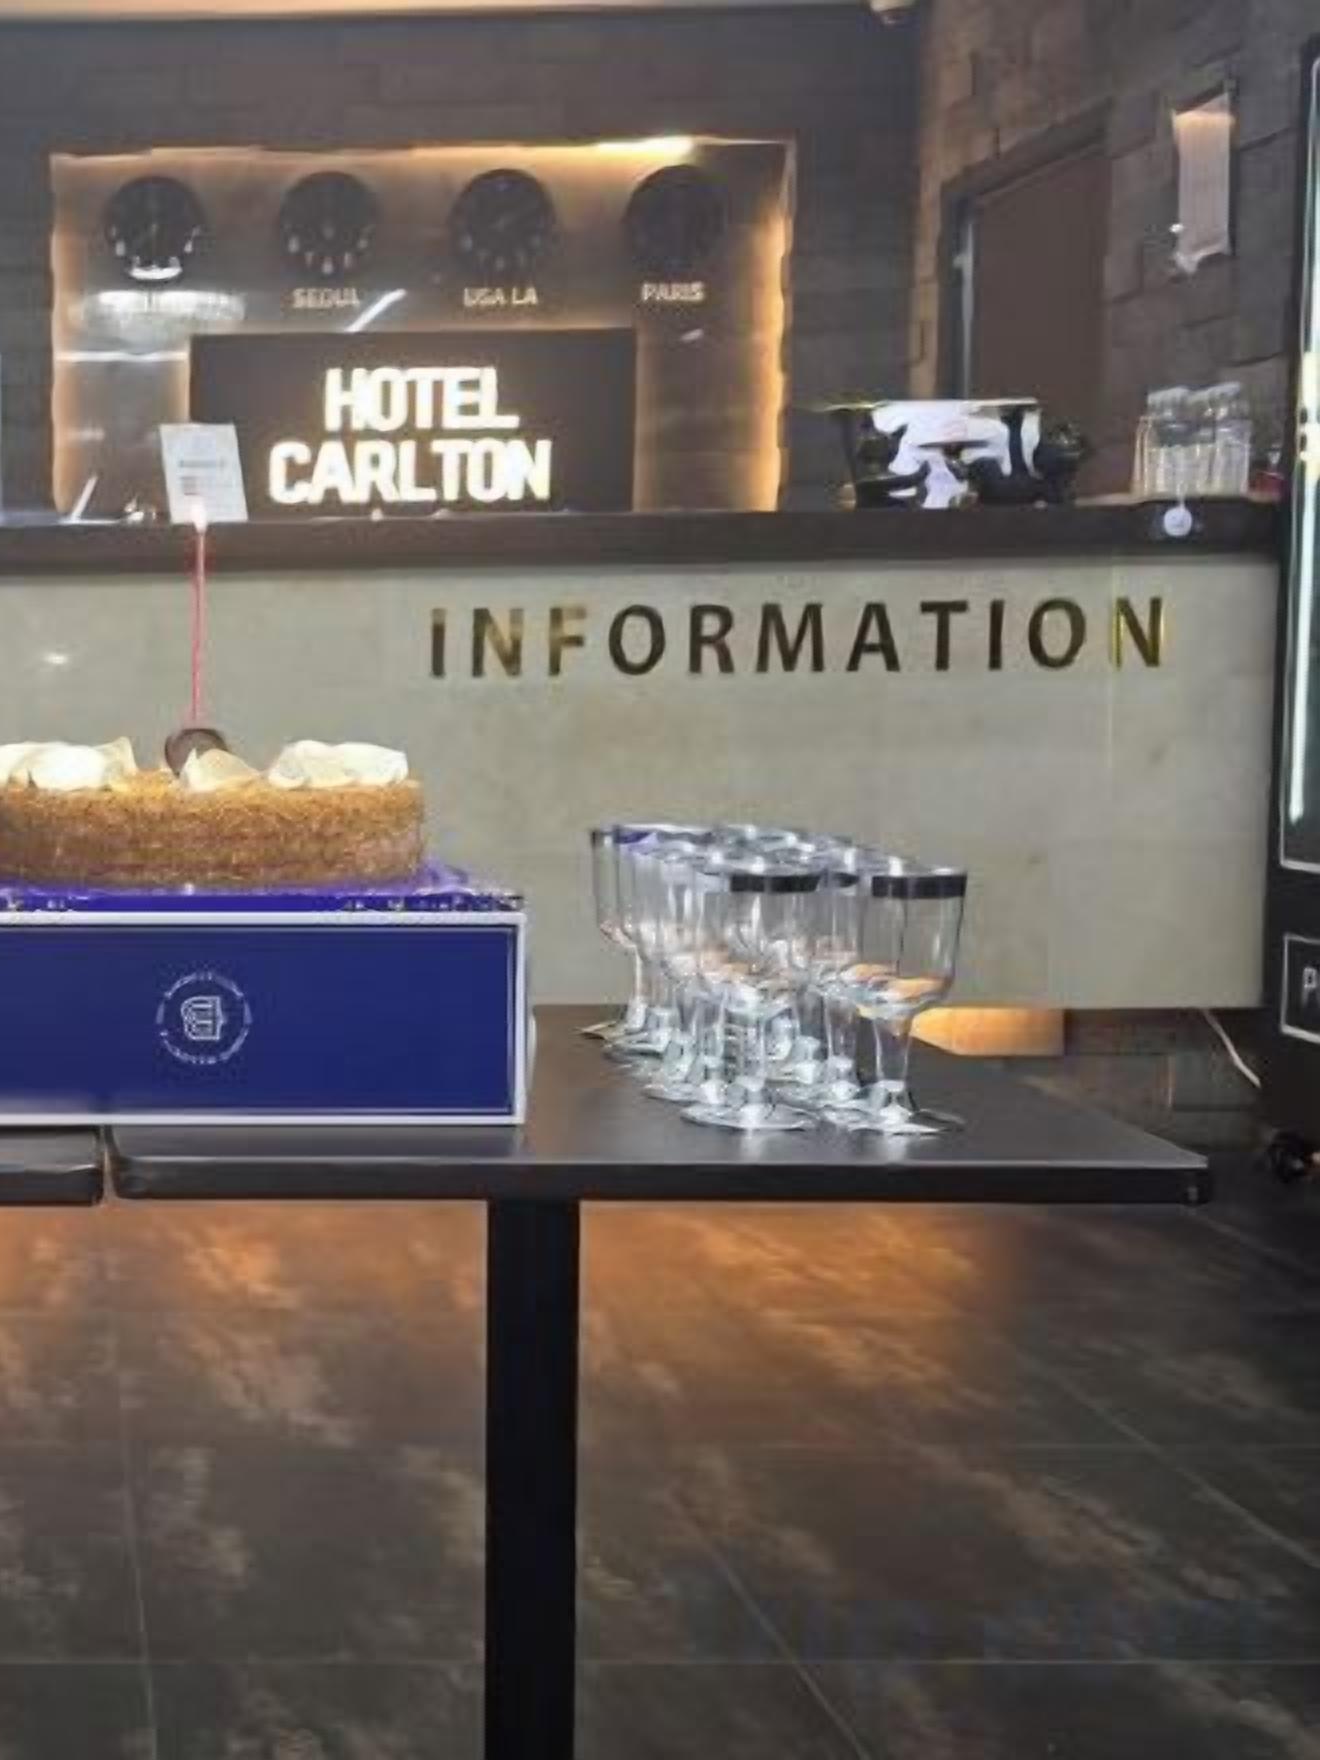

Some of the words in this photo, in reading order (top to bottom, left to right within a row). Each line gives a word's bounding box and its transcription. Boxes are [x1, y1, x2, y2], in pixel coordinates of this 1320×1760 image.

[511, 286, 538, 305] LA
[642, 281, 704, 301] PARIS
[325, 366, 520, 431] HOTEL
[269, 437, 552, 504] CARLTON
[431, 596, 1163, 678] INFORMATION
